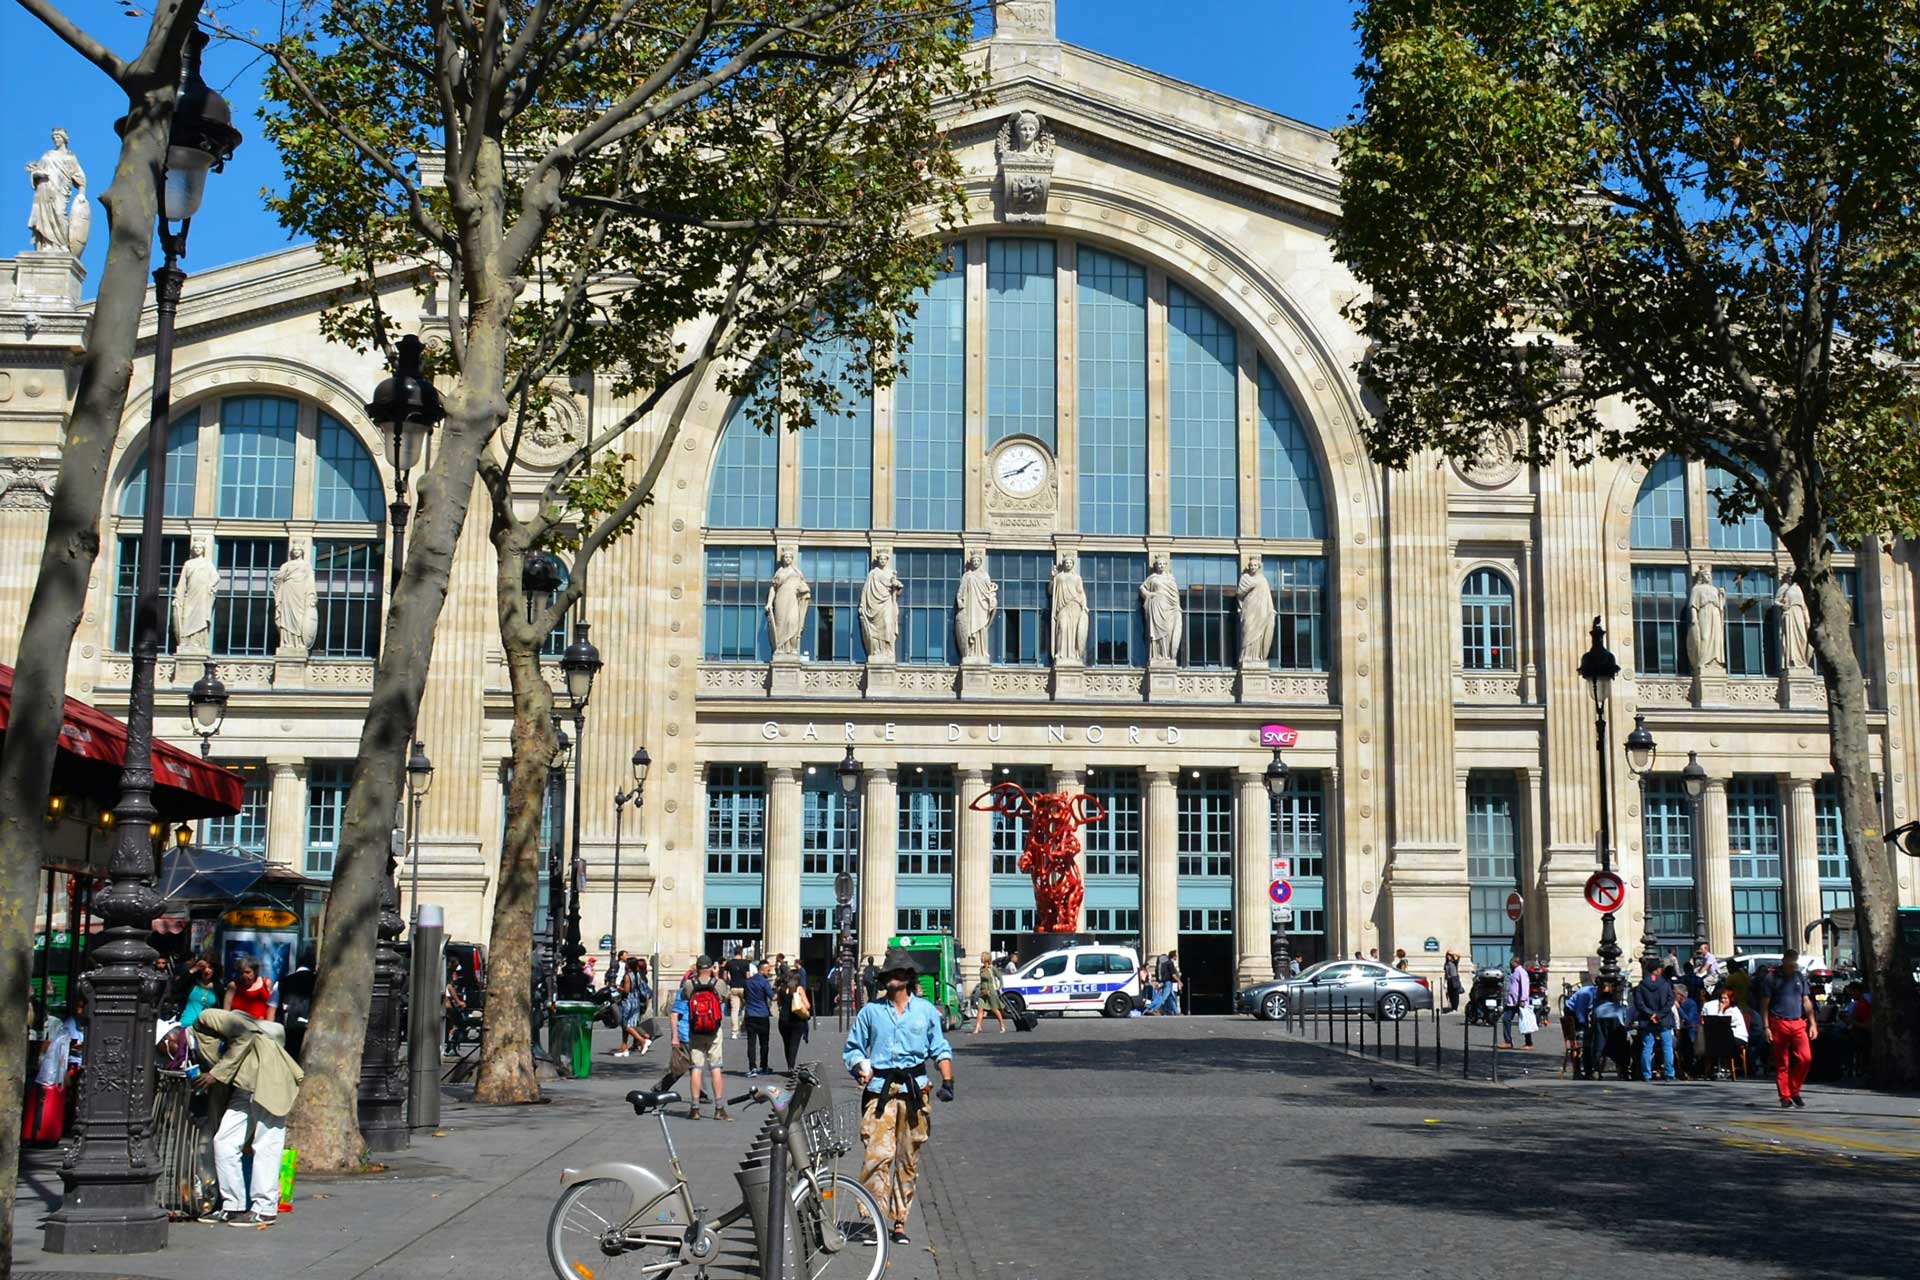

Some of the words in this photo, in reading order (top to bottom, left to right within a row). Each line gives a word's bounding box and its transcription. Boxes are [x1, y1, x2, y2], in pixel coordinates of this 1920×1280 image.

[761, 721, 896, 742] GARE
[948, 723, 1001, 743] DU
[1047, 724, 1183, 745] NORD
[1263, 732, 1297, 743] SNCF
[1052, 983, 1098, 994] POLICE
